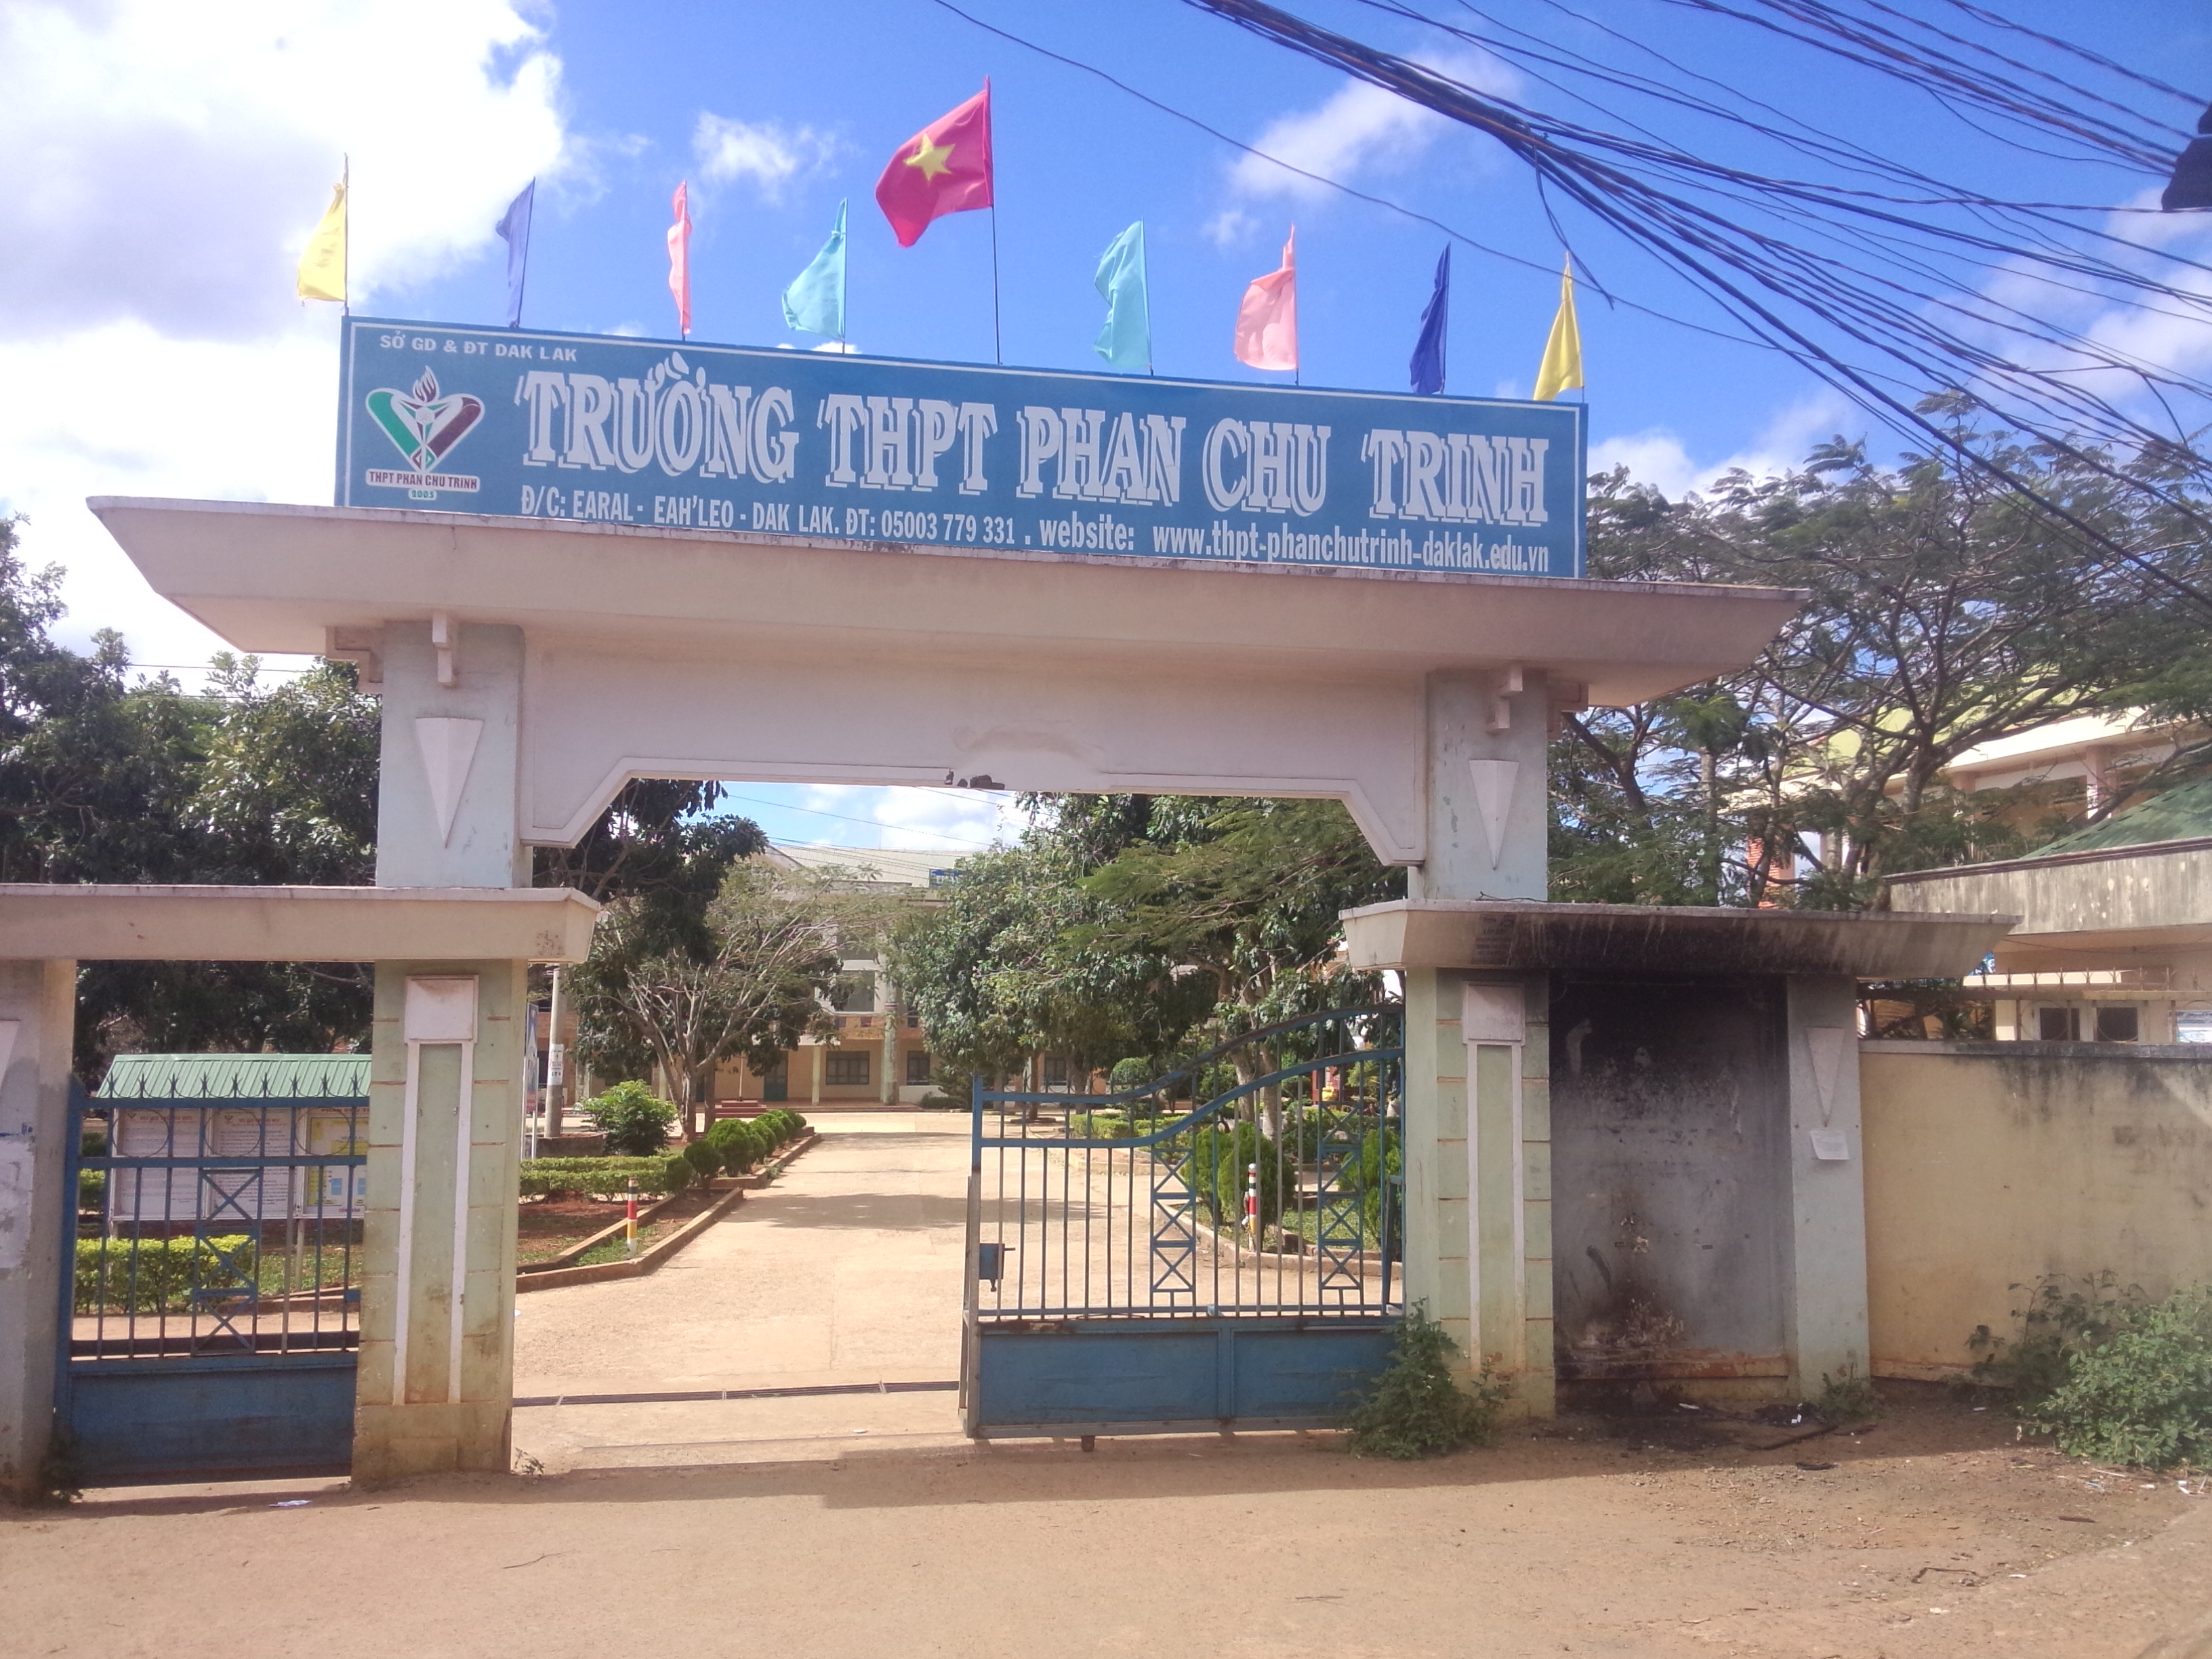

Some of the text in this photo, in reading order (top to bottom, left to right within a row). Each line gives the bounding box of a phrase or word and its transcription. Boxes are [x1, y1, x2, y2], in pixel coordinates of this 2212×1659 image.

[411, 337, 436, 350] GD
[443, 340, 457, 352] &
[464, 341, 488, 354] ĐT
[495, 344, 533, 359] DAK
[539, 347, 577, 361] LAK
[514, 350, 1549, 527] TRƯỜNG THPT PHAN CHU TRINH
[369, 471, 478, 490] THPT PHAN CHU TRINH
[521, 485, 565, 517] Đ/C:
[752, 502, 790, 533] DAK
[846, 507, 876, 537] ĐT:
[881, 509, 937, 540] 05003
[943, 513, 977, 542] 779
[983, 516, 1015, 545] 331
[1040, 511, 1134, 551] website:
[1153, 519, 1549, 573] www.thpt-phanchutrinh-daklak.edu.vn
